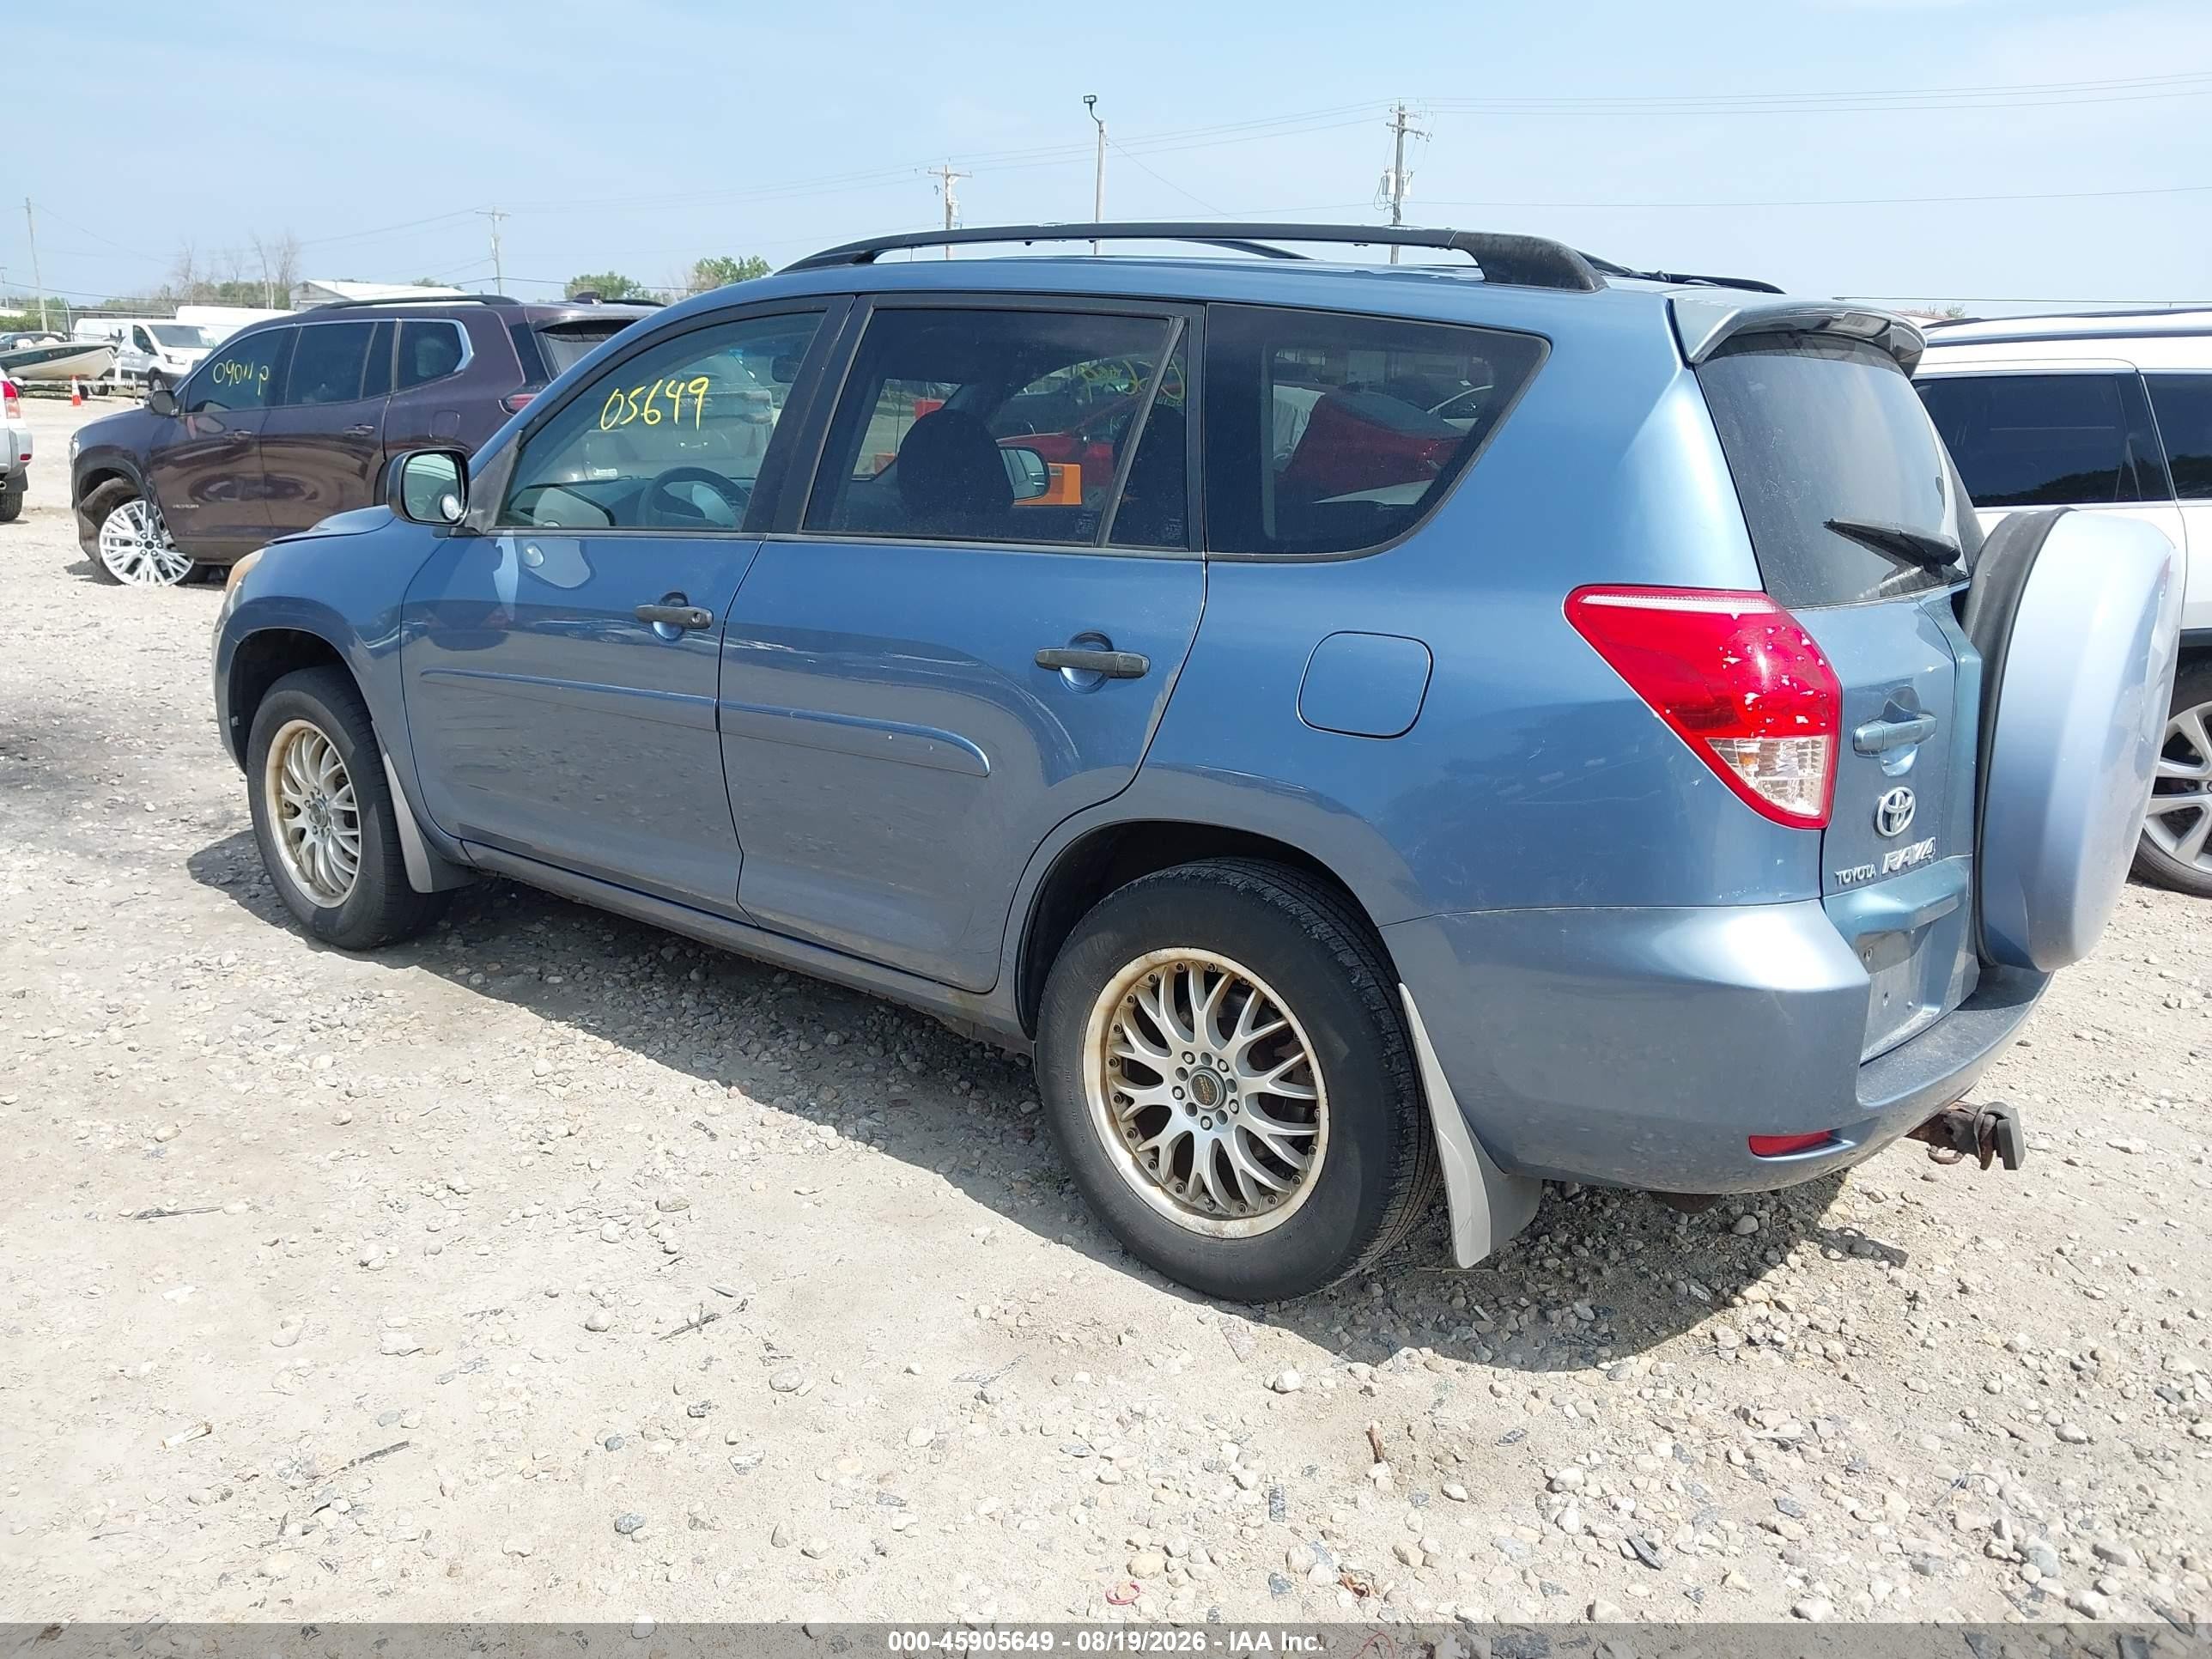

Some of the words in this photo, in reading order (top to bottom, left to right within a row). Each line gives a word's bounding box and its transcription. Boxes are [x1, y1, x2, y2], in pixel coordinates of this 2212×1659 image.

[213, 359, 254, 386] 09011
[600, 377, 709, 431] 05649
[1834, 864, 1876, 885] TOYOTA
[1881, 836, 1936, 875] RAV4
